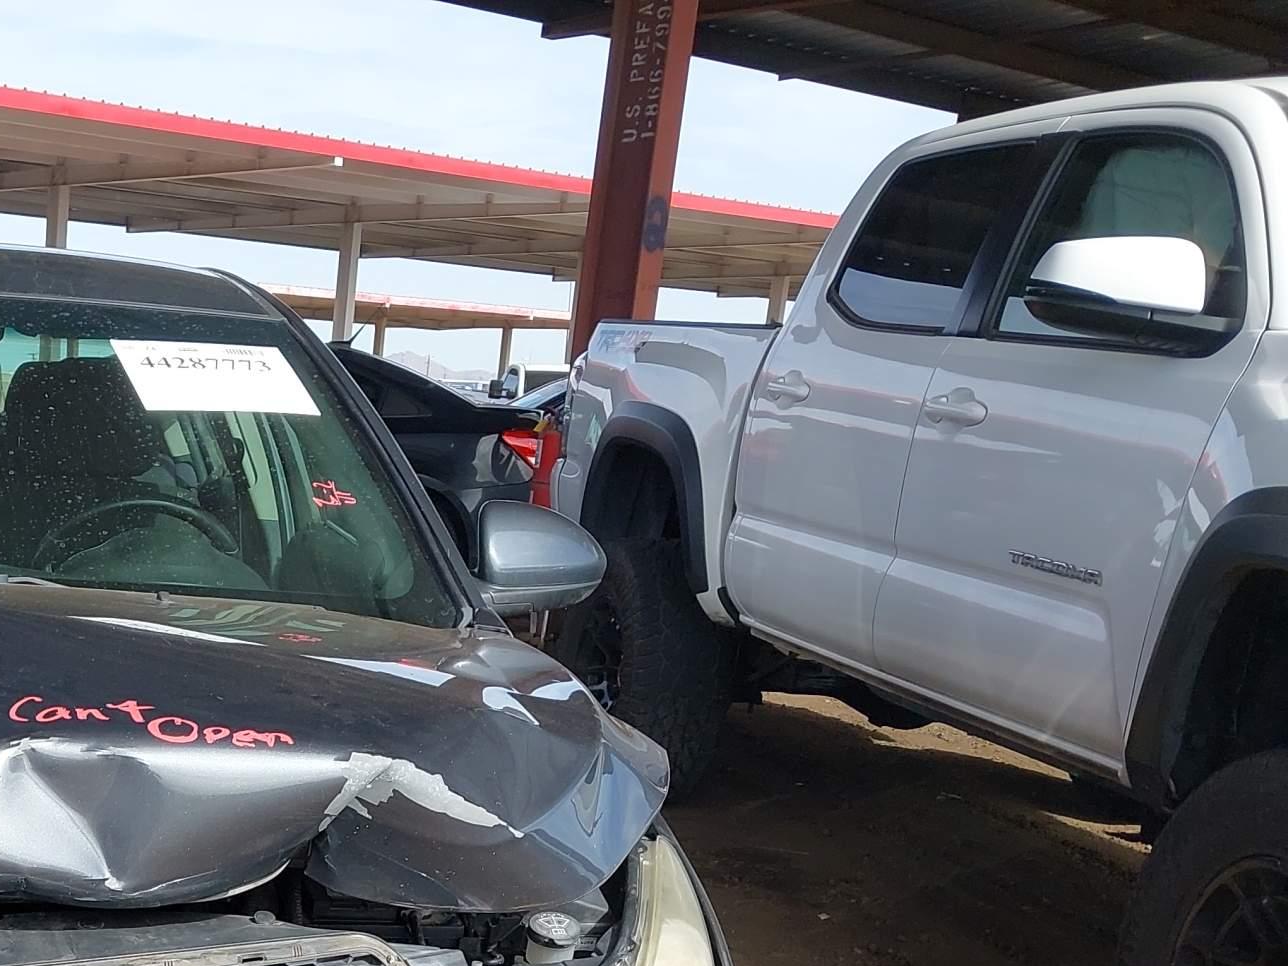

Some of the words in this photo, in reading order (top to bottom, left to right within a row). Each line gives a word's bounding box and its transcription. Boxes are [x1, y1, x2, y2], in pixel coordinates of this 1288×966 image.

[640, 0, 672, 139] 1-866-799
[621, 96, 642, 143] U.S.
[139, 356, 272, 373] 44287773
[1008, 549, 1103, 587] TACOMA
[147, 716, 295, 748] Open
